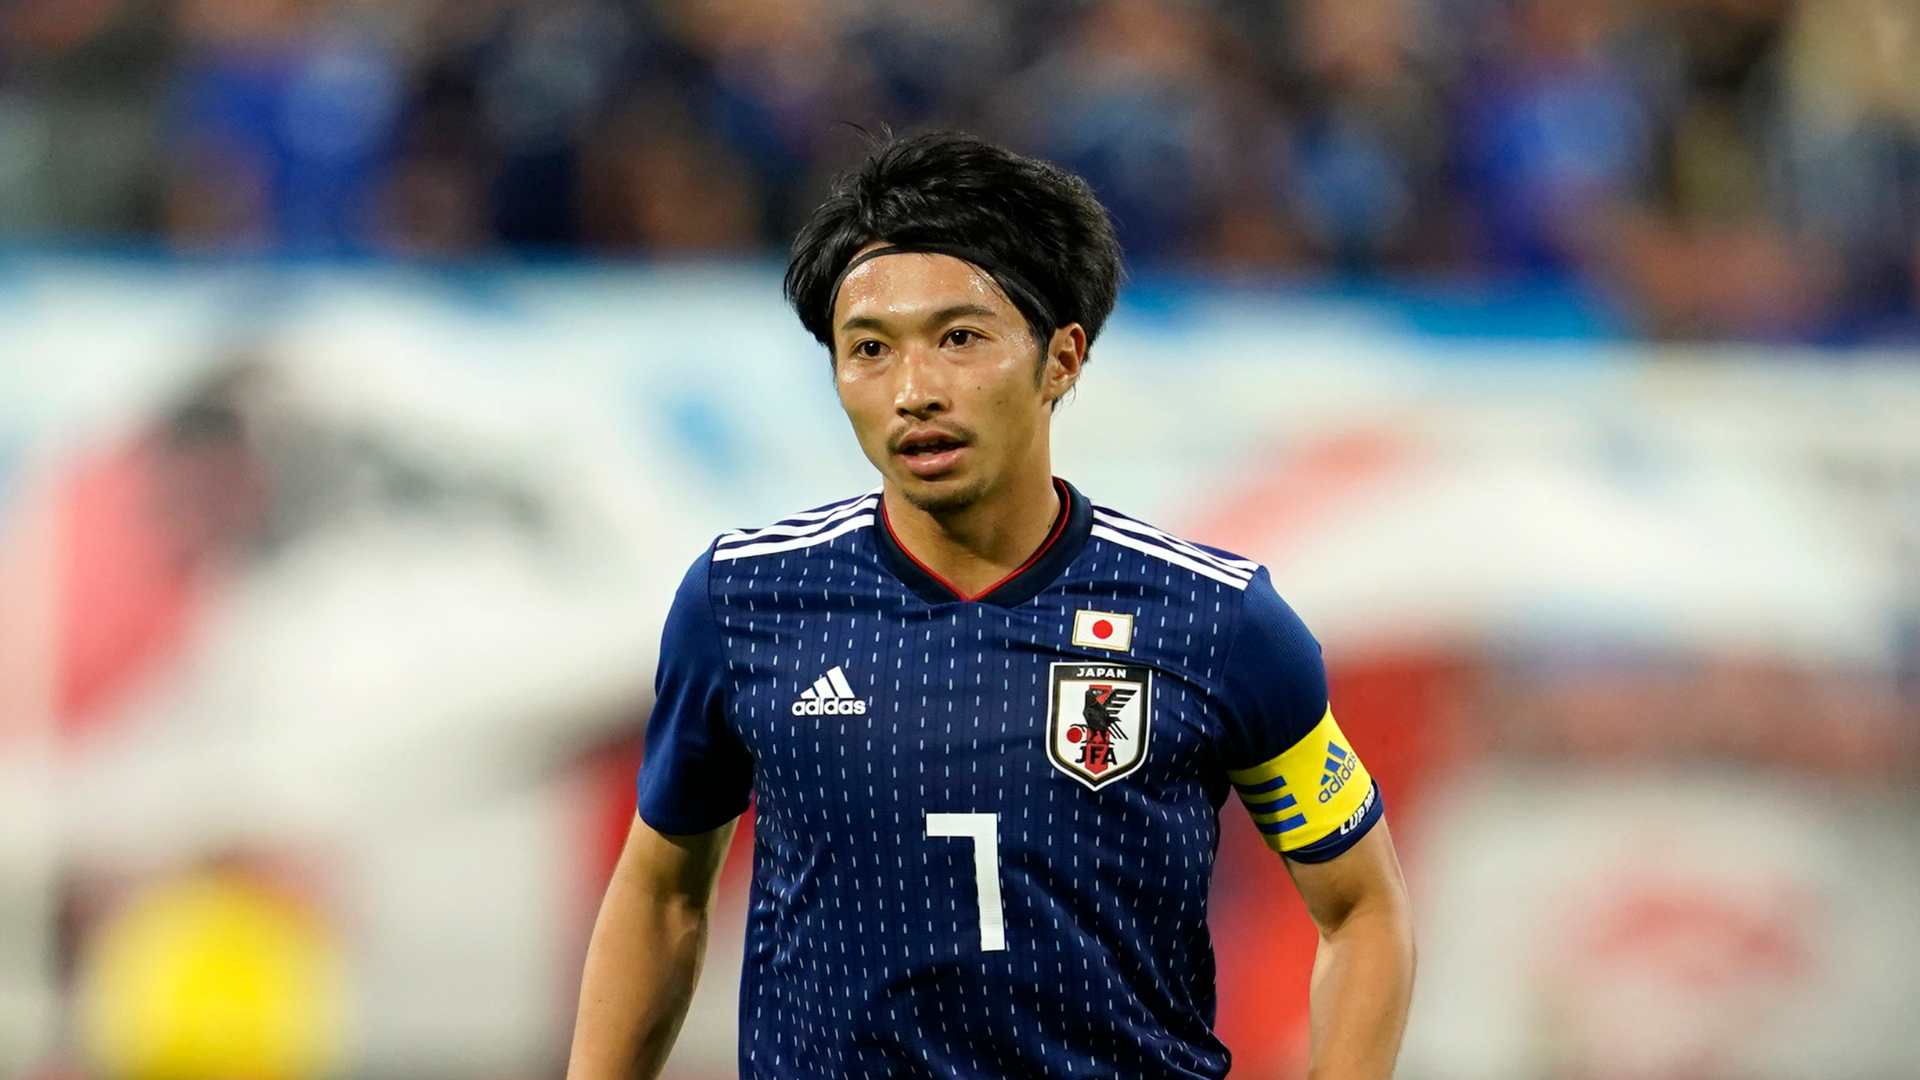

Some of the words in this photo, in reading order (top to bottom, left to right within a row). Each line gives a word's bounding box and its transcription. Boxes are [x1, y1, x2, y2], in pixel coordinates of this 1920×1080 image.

[1076, 667, 1127, 679] JAPAN
[791, 697, 866, 716] adidas
[1074, 745, 1118, 766] JFA
[926, 812, 1006, 952] 7
